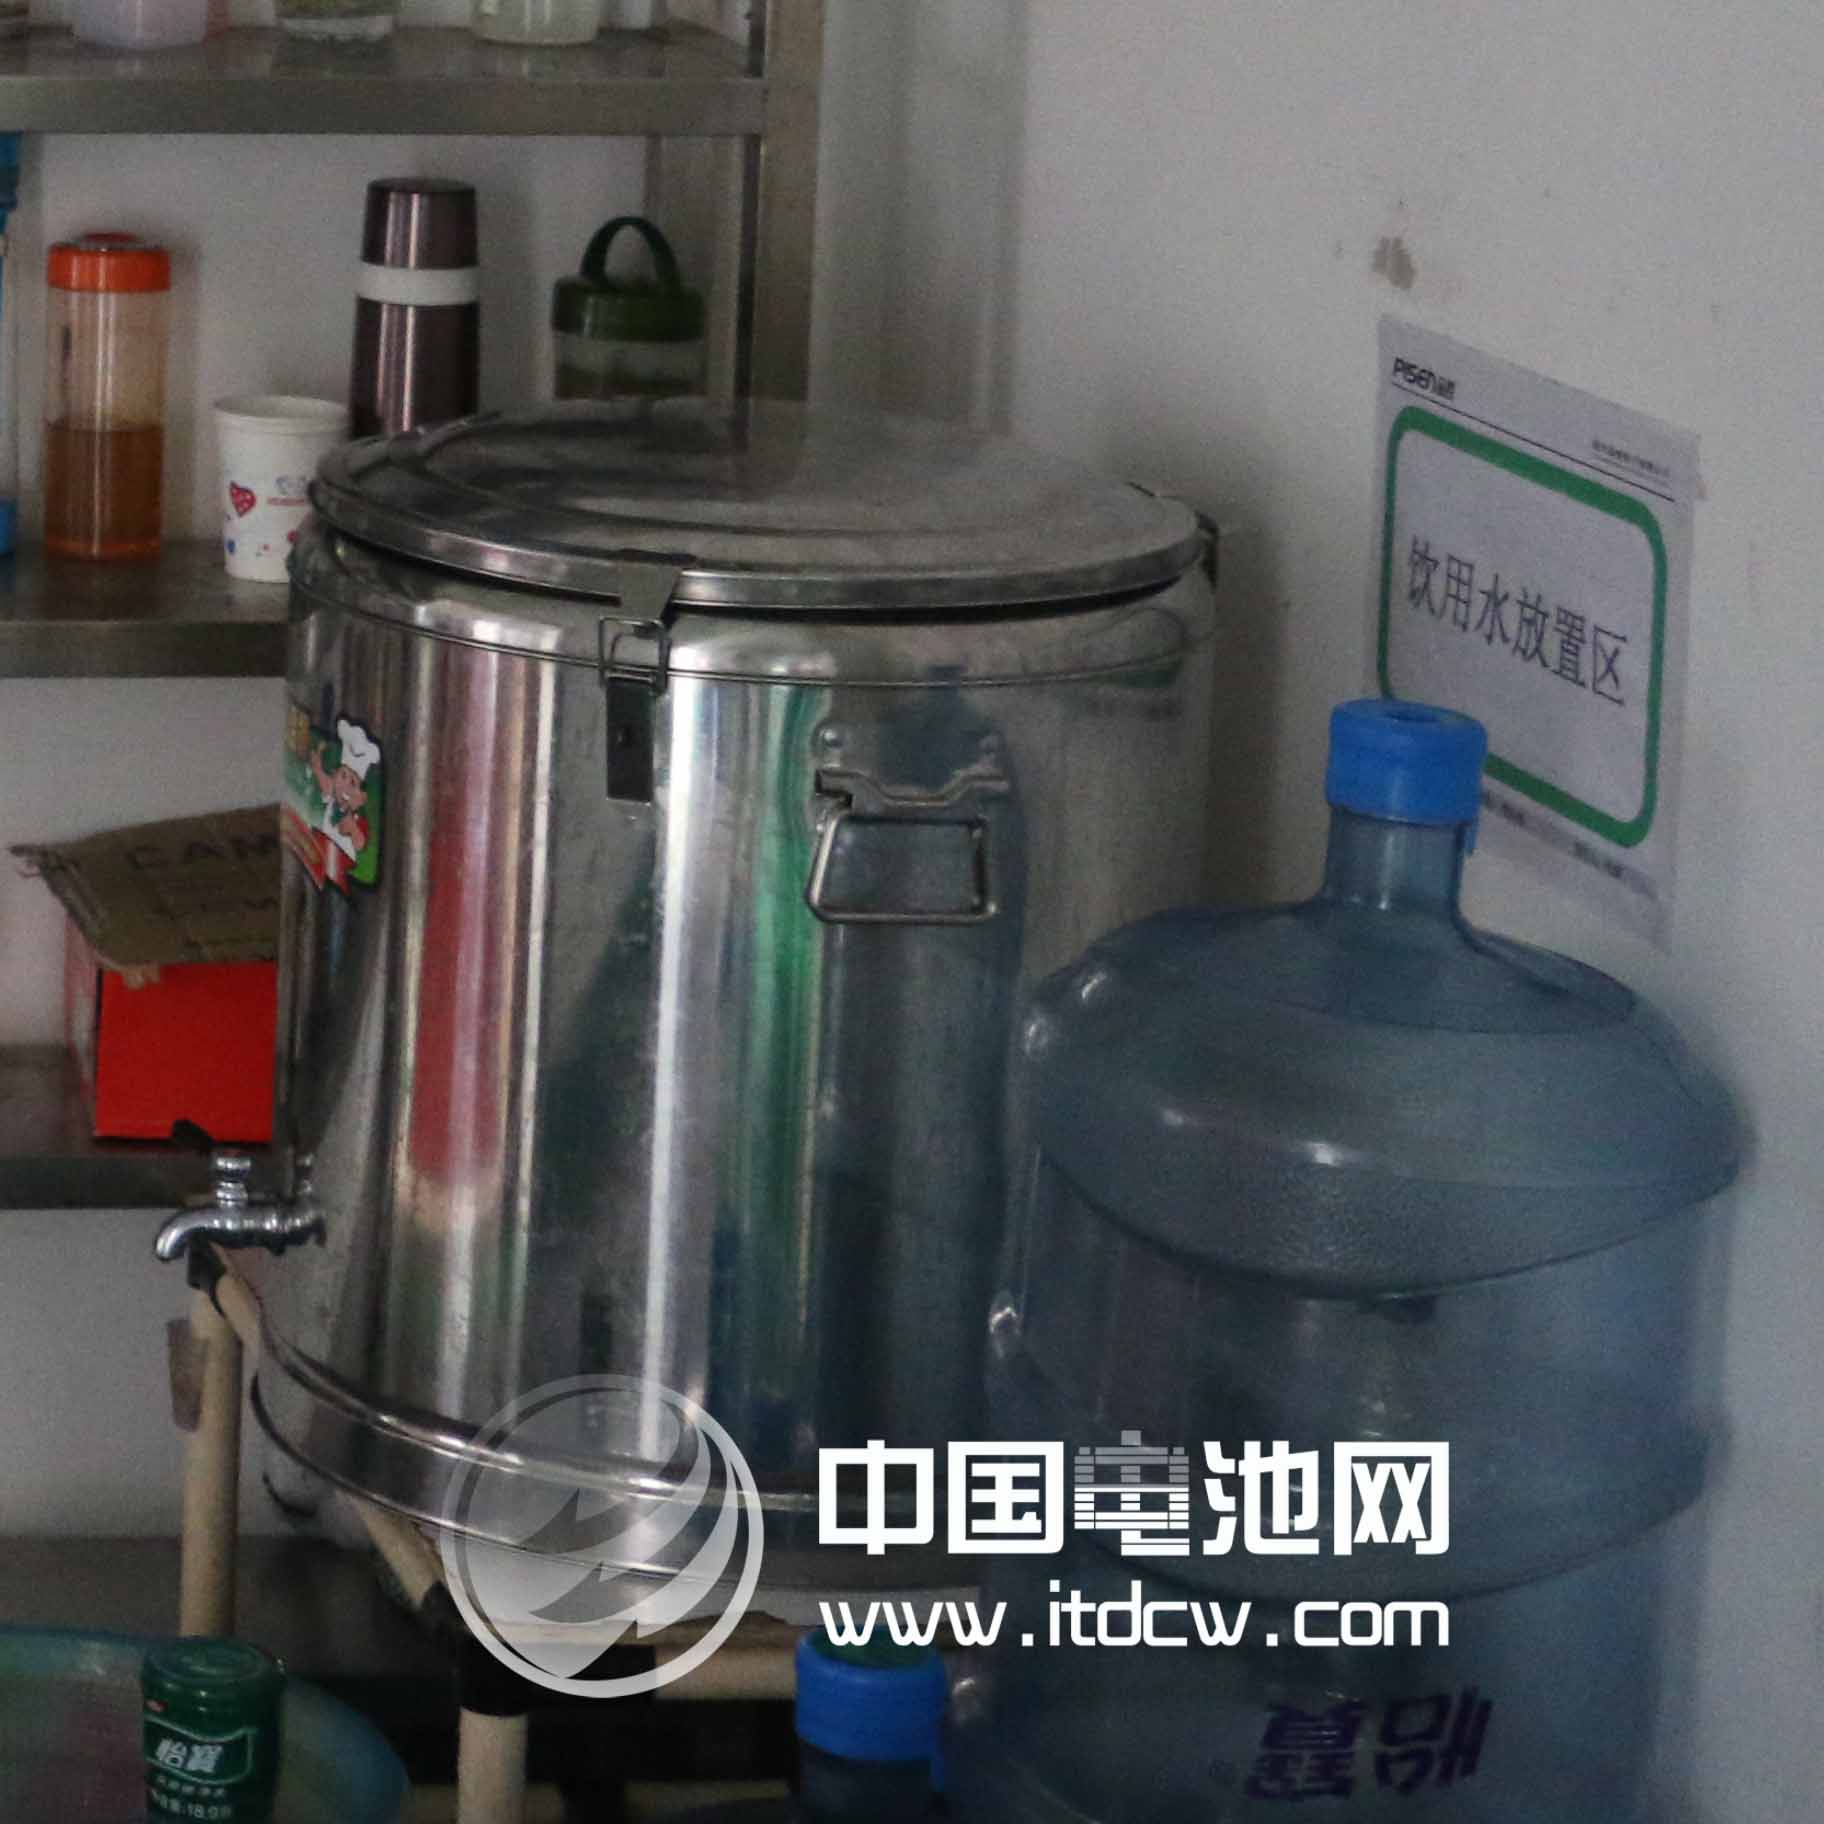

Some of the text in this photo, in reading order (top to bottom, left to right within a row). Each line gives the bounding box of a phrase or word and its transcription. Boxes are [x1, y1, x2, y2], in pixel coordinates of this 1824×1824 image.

[1406, 533, 1629, 706] 饮用水放置区
